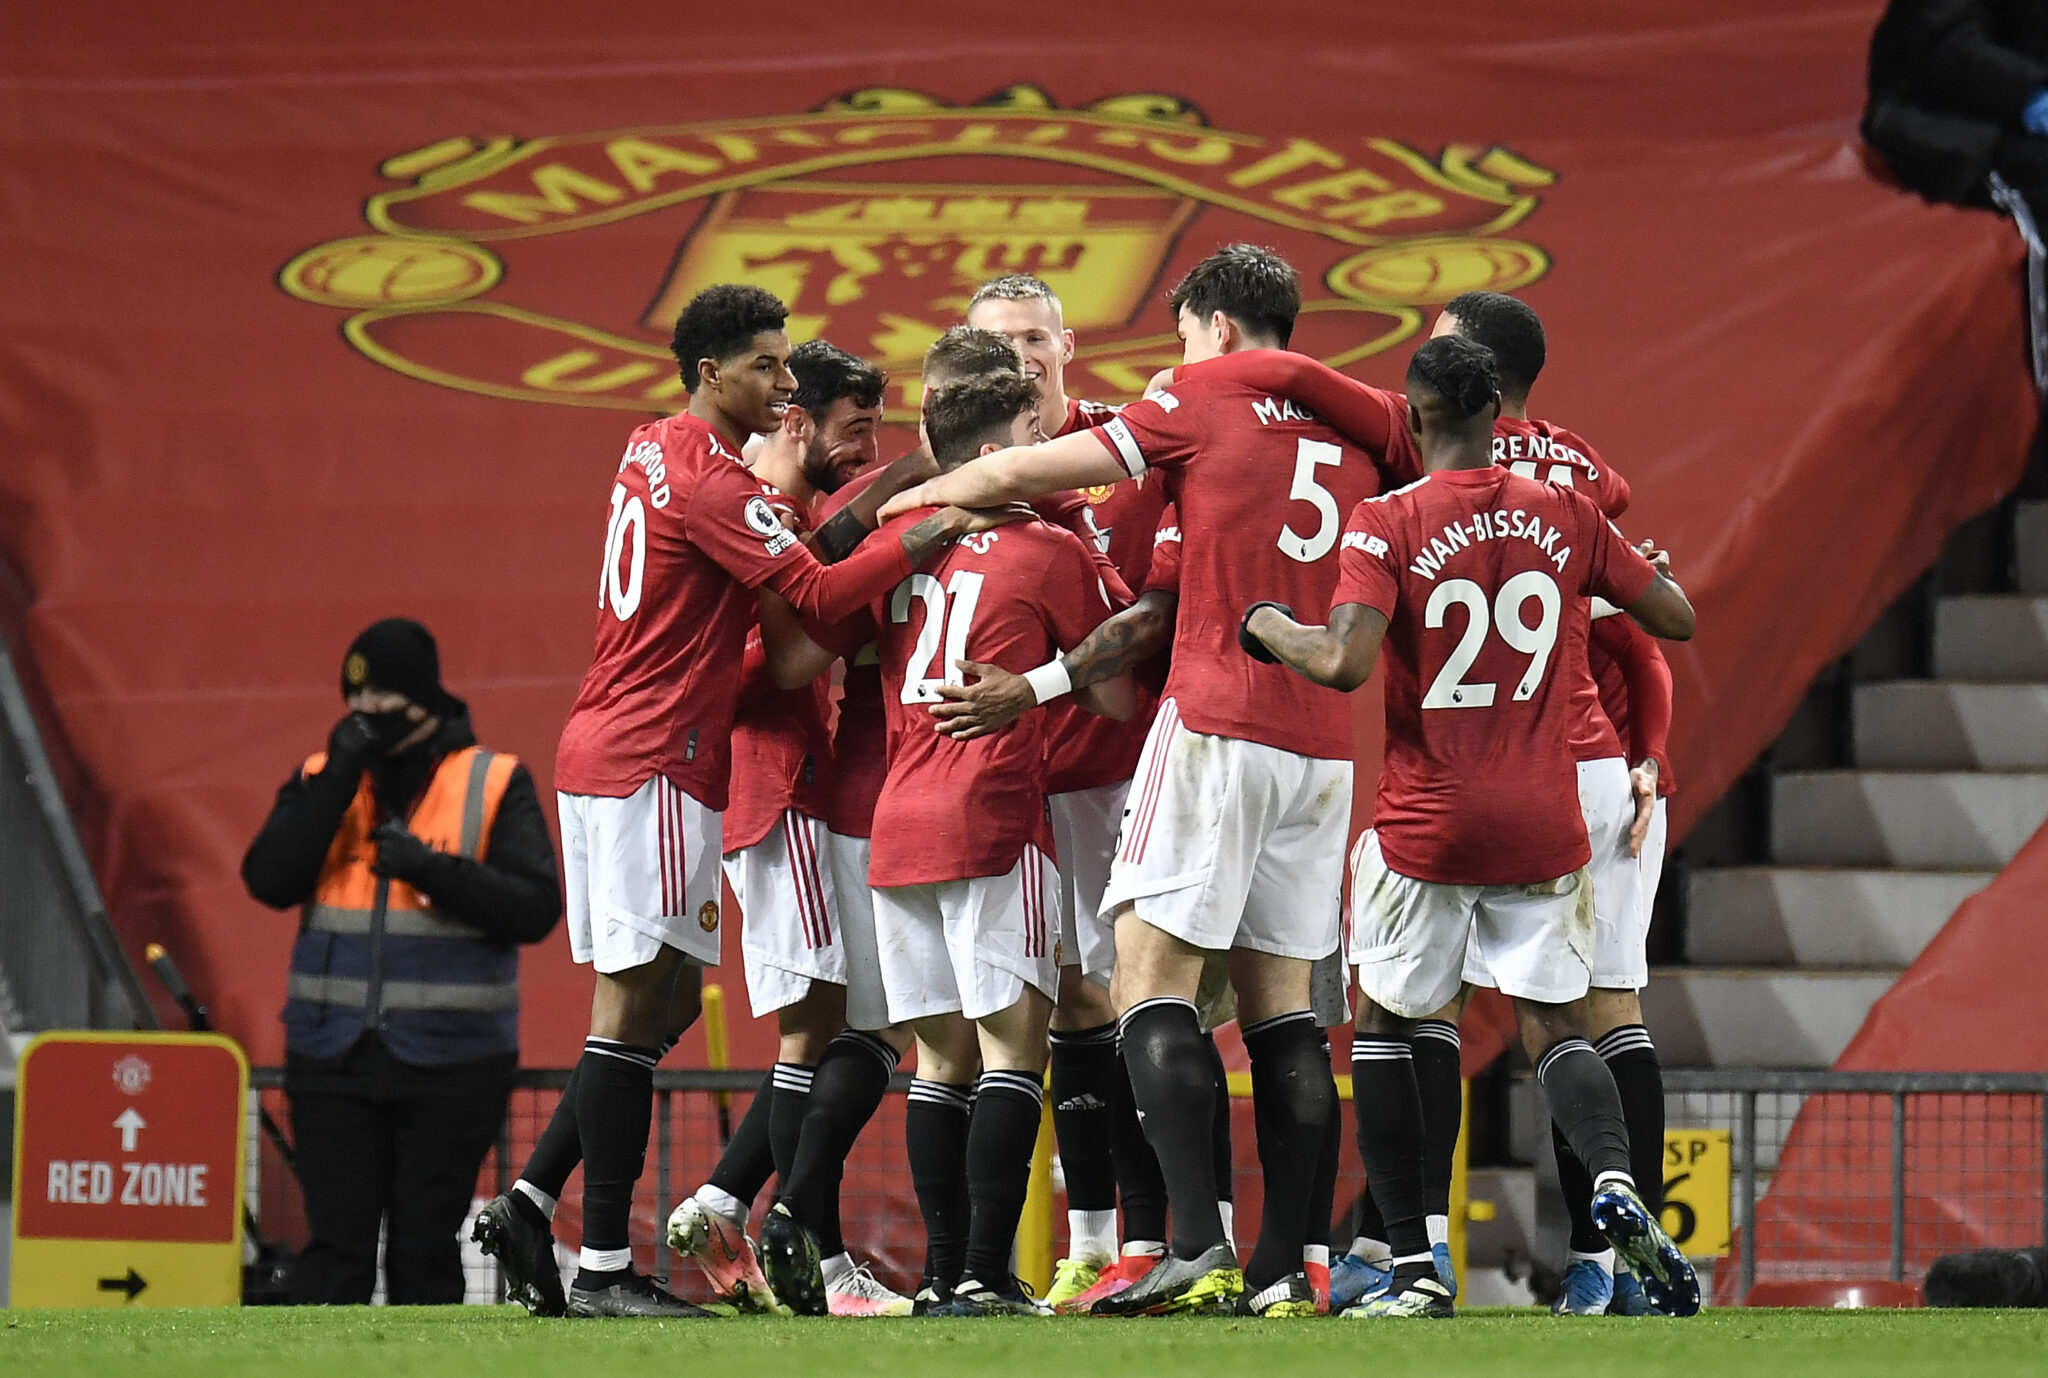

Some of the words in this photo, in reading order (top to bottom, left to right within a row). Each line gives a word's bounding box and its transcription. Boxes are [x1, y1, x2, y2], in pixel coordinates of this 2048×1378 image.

[598, 482, 646, 622] 10
[1276, 437, 1342, 563] 5
[1409, 509, 1571, 581] WAN-BISSAKA
[891, 570, 985, 705] 21
[1421, 570, 1562, 709] 29
[47, 1160, 113, 1205] RED
[120, 1162, 208, 1207] ZONE
[1659, 1172, 1696, 1244] 6
